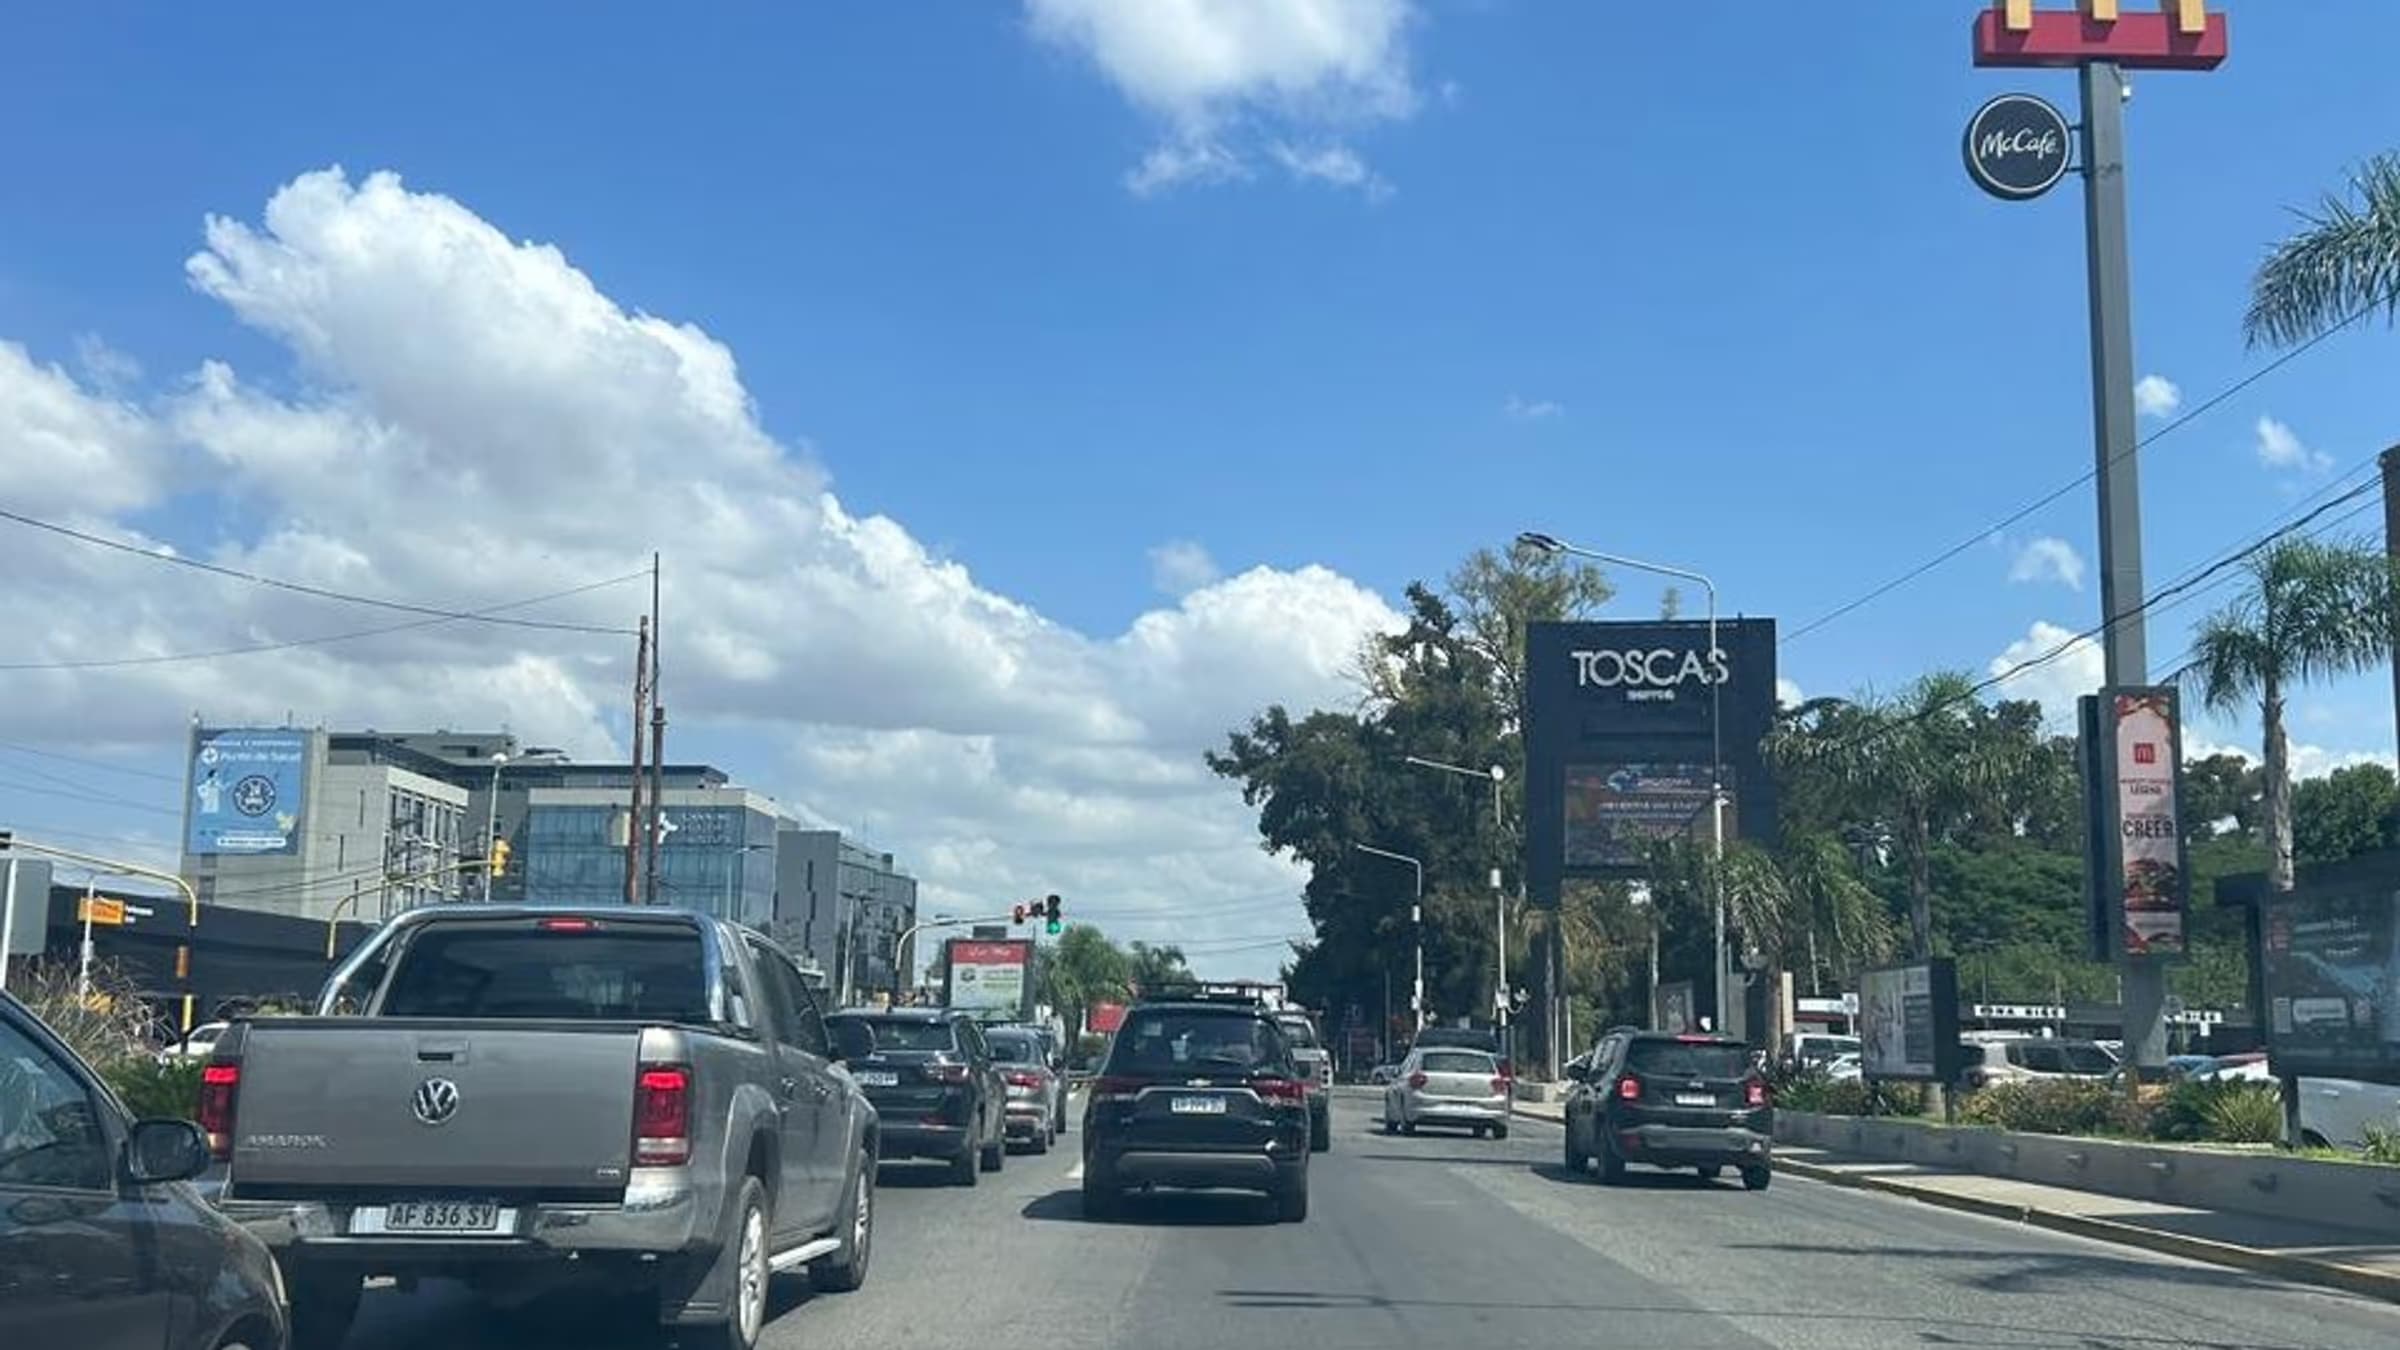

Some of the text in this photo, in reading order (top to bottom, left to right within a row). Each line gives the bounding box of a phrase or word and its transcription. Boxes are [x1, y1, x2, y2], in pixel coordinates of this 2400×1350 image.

[1980, 127, 2057, 159] McCafé
[1571, 649, 1729, 686] TOSCAS
[391, 1203, 417, 1226] AF
[423, 1204, 461, 1226] 836
